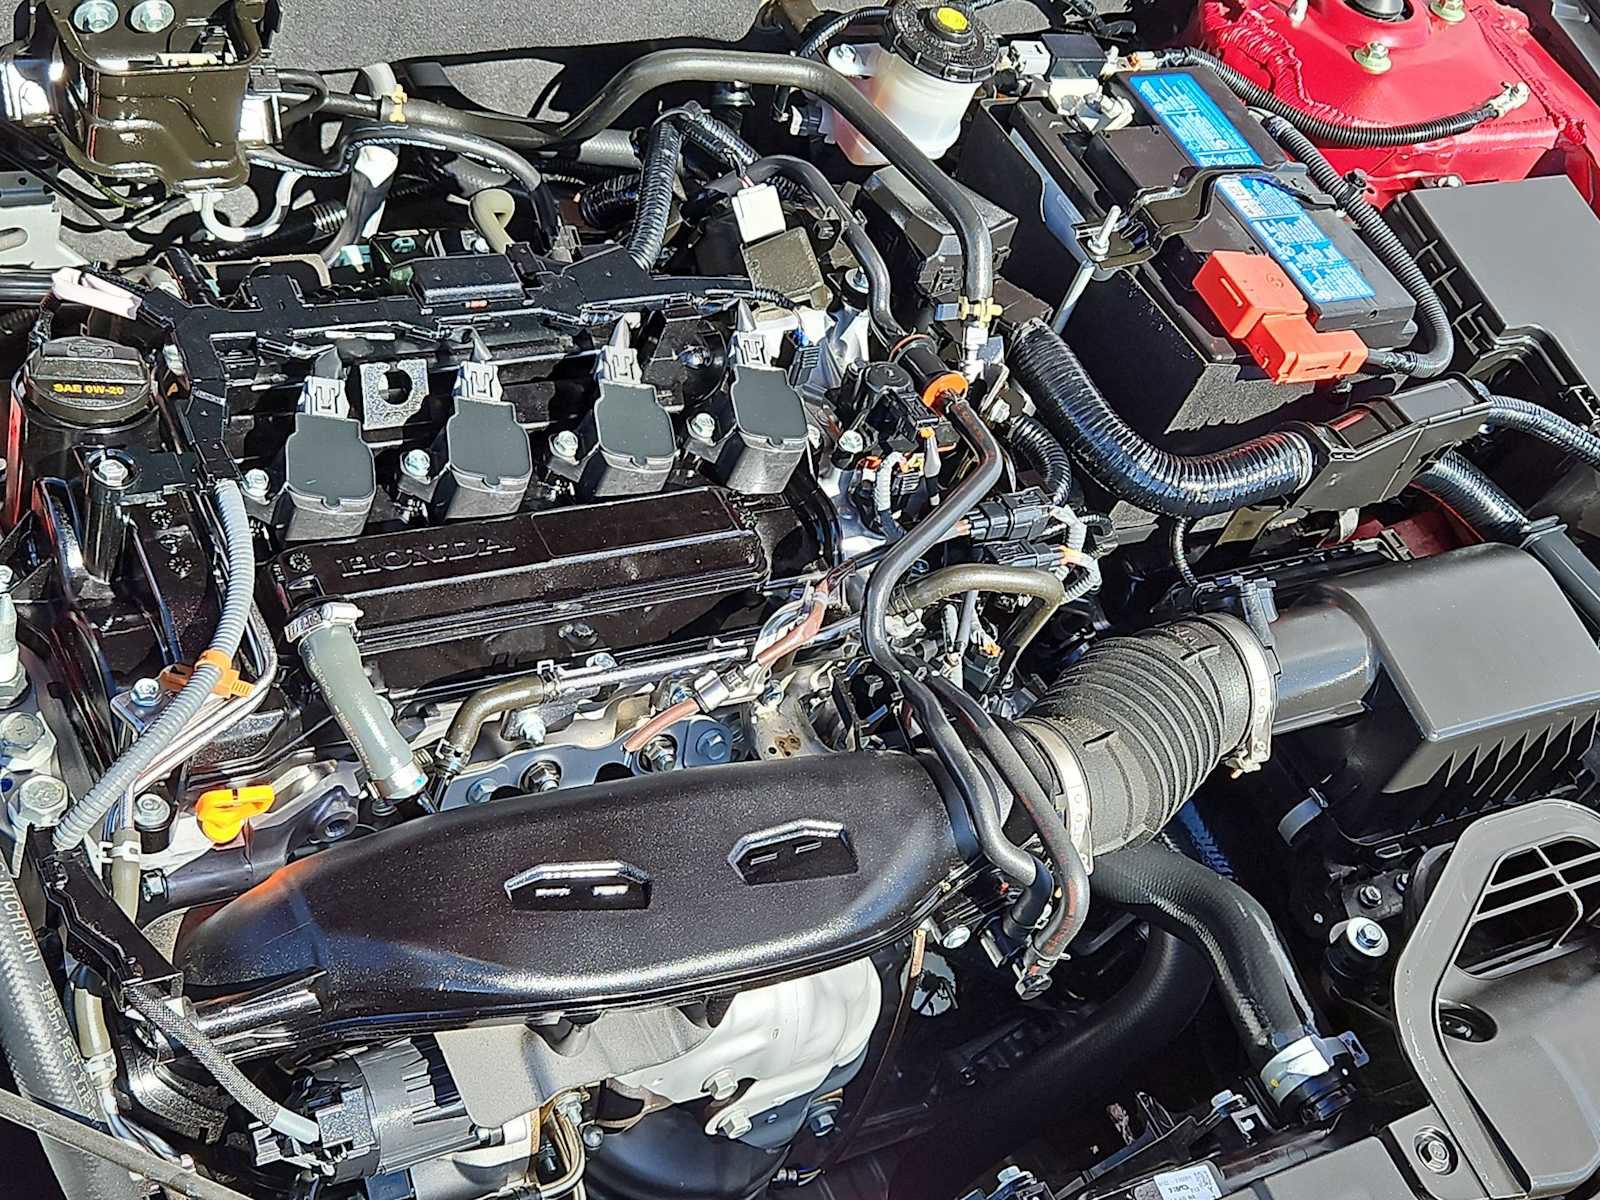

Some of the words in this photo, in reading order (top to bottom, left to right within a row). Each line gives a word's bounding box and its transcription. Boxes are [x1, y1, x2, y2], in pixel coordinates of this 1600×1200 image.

[53, 383, 82, 393] SAE
[84, 384, 125, 395] 0W-20
[335, 538, 516, 577] HONDA
